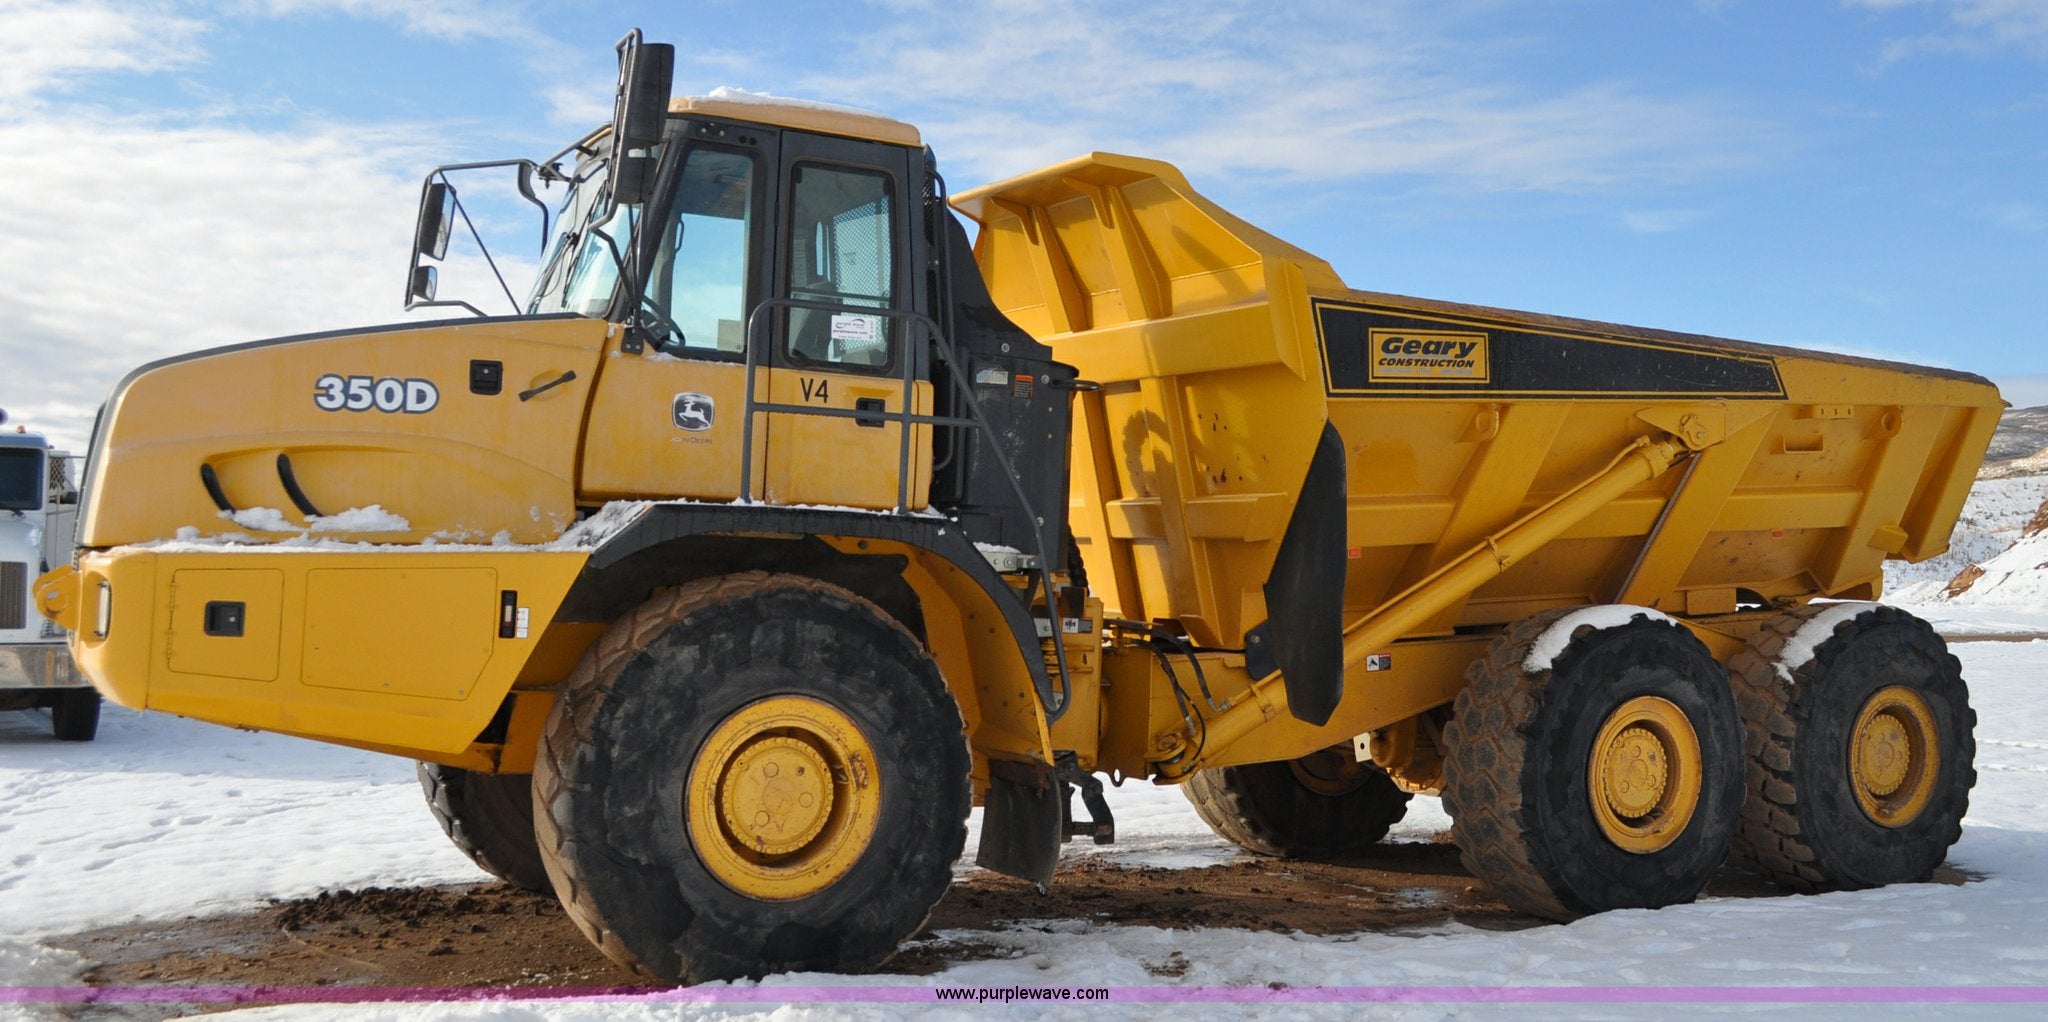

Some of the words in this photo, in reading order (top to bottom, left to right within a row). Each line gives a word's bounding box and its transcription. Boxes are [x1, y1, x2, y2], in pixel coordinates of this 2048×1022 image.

[1381, 336, 1479, 359] Geary
[1378, 357, 1475, 368] CONSTRUCTION
[314, 373, 440, 414] 350D
[800, 377, 829, 403] V4
